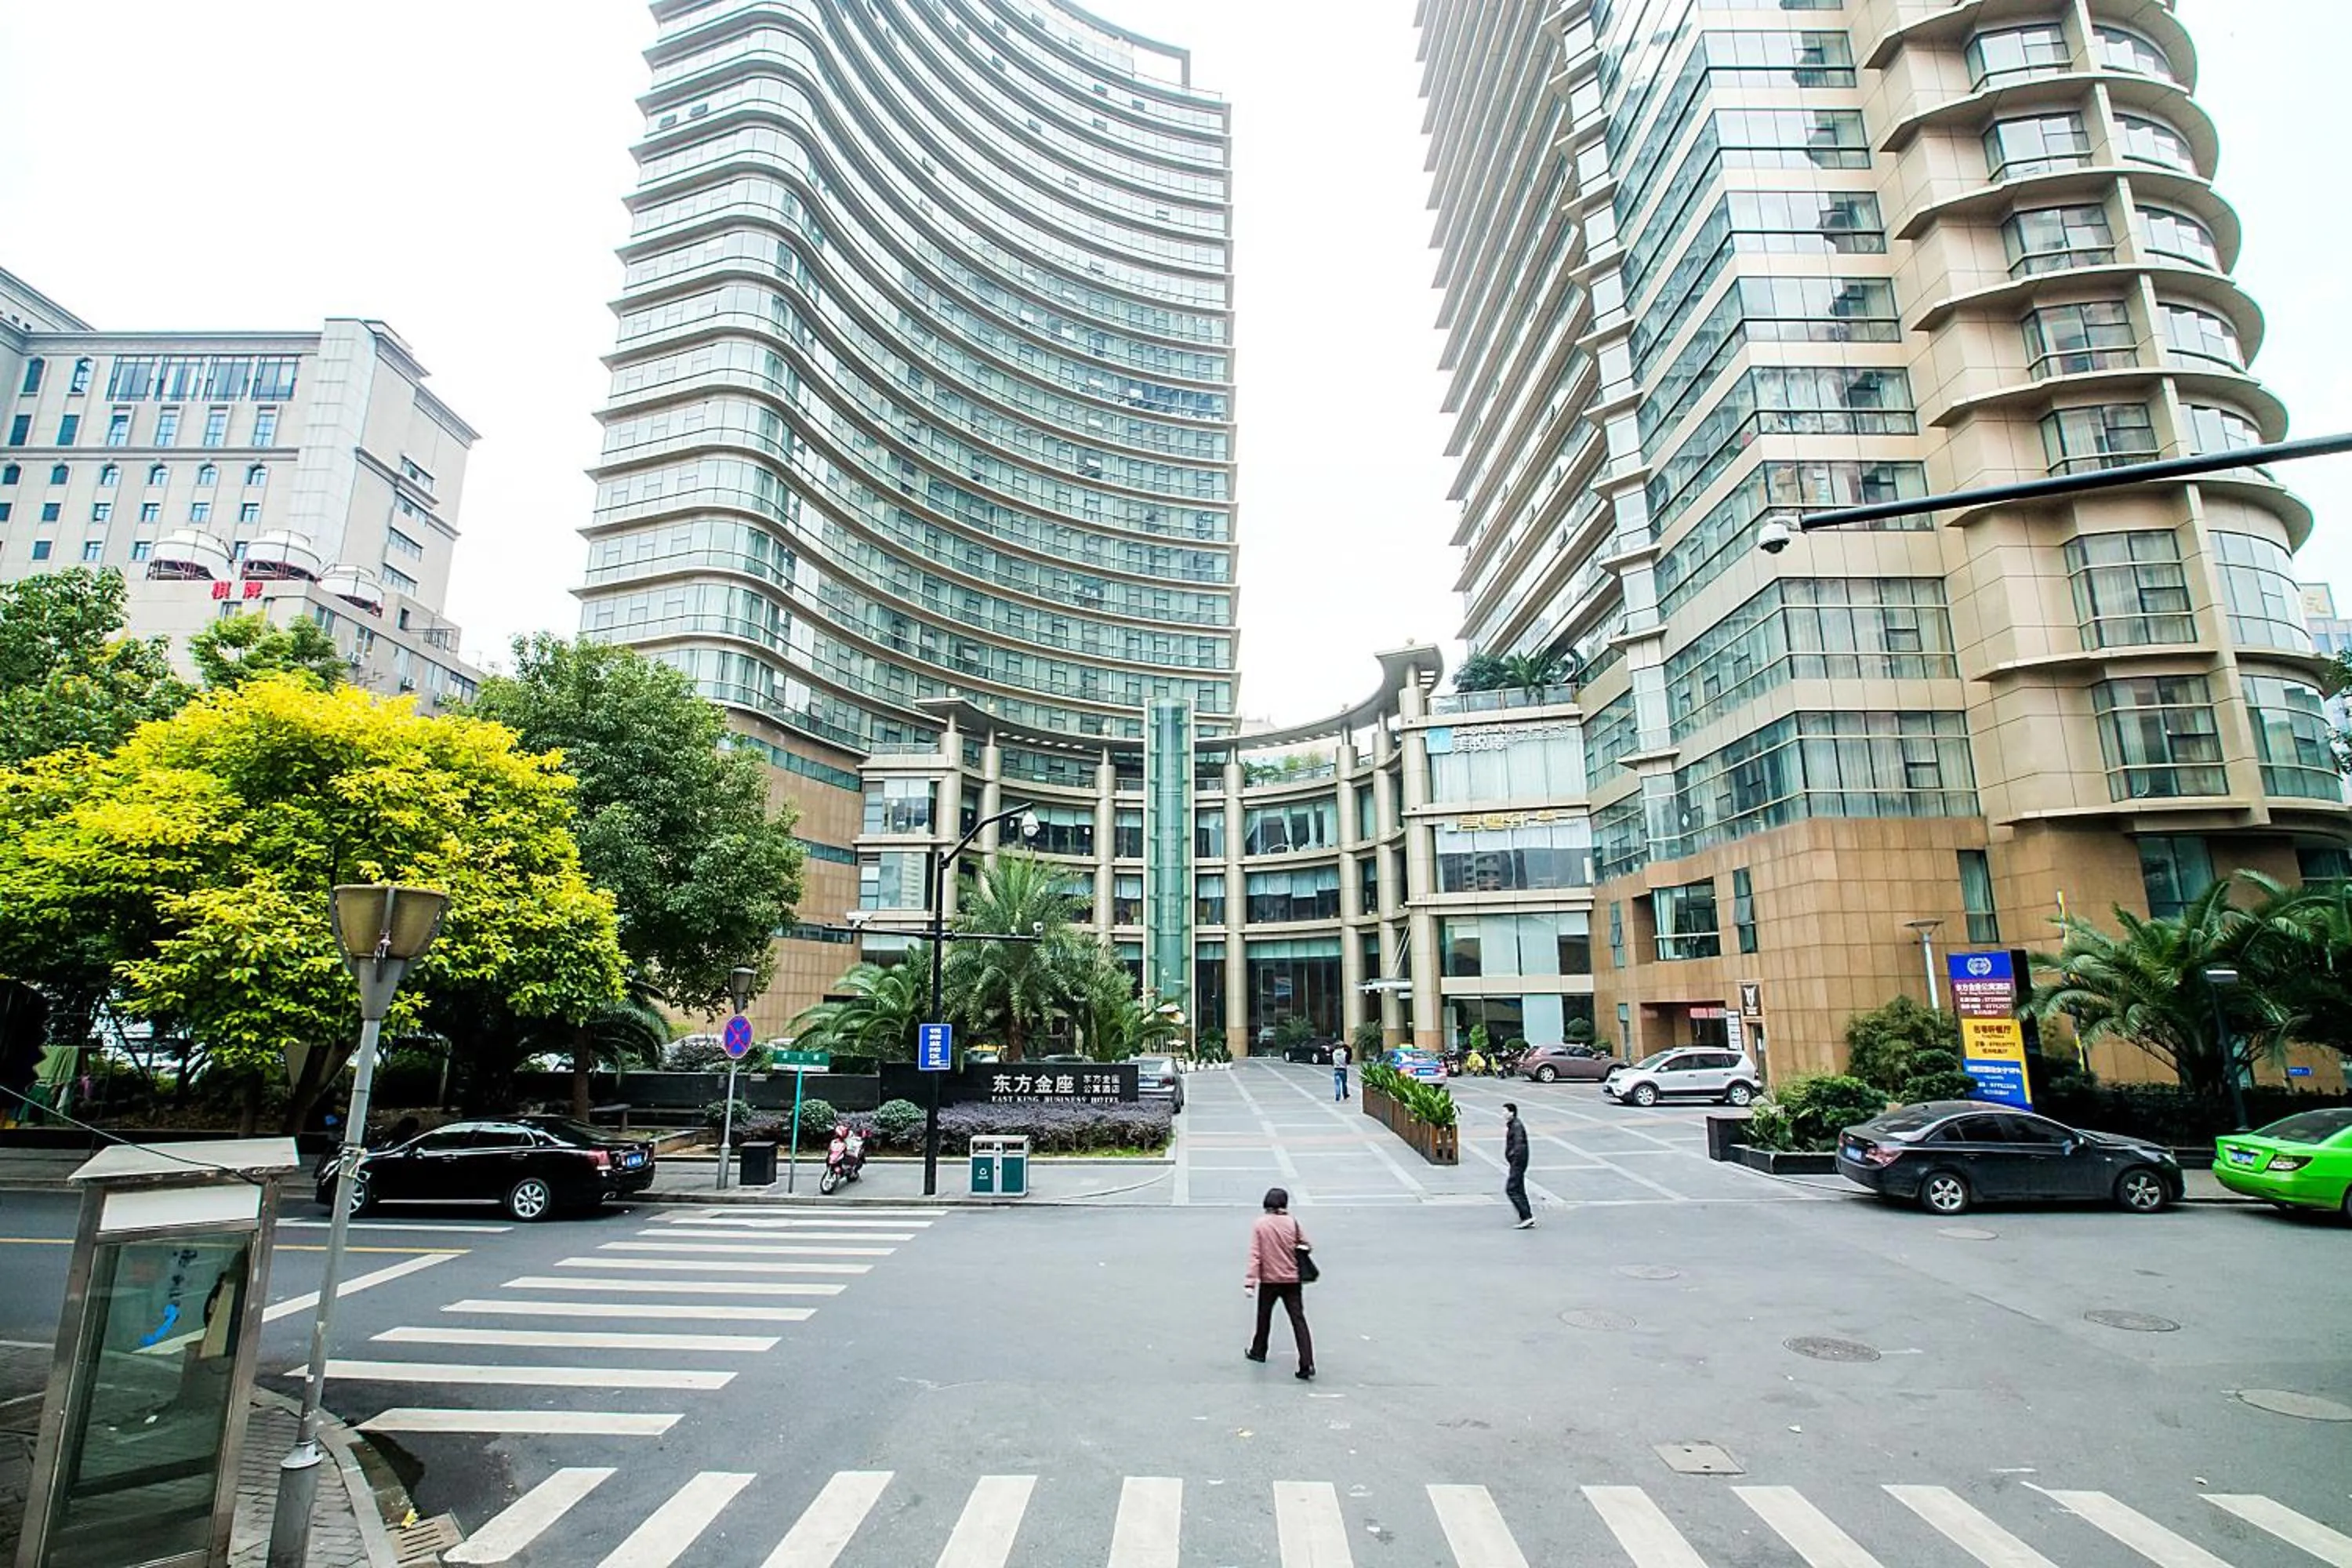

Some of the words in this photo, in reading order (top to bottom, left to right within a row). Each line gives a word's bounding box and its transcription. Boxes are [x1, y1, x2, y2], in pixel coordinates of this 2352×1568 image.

[212, 581, 263, 600] 棋牌
[992, 1073, 1075, 1094] 东方金座
